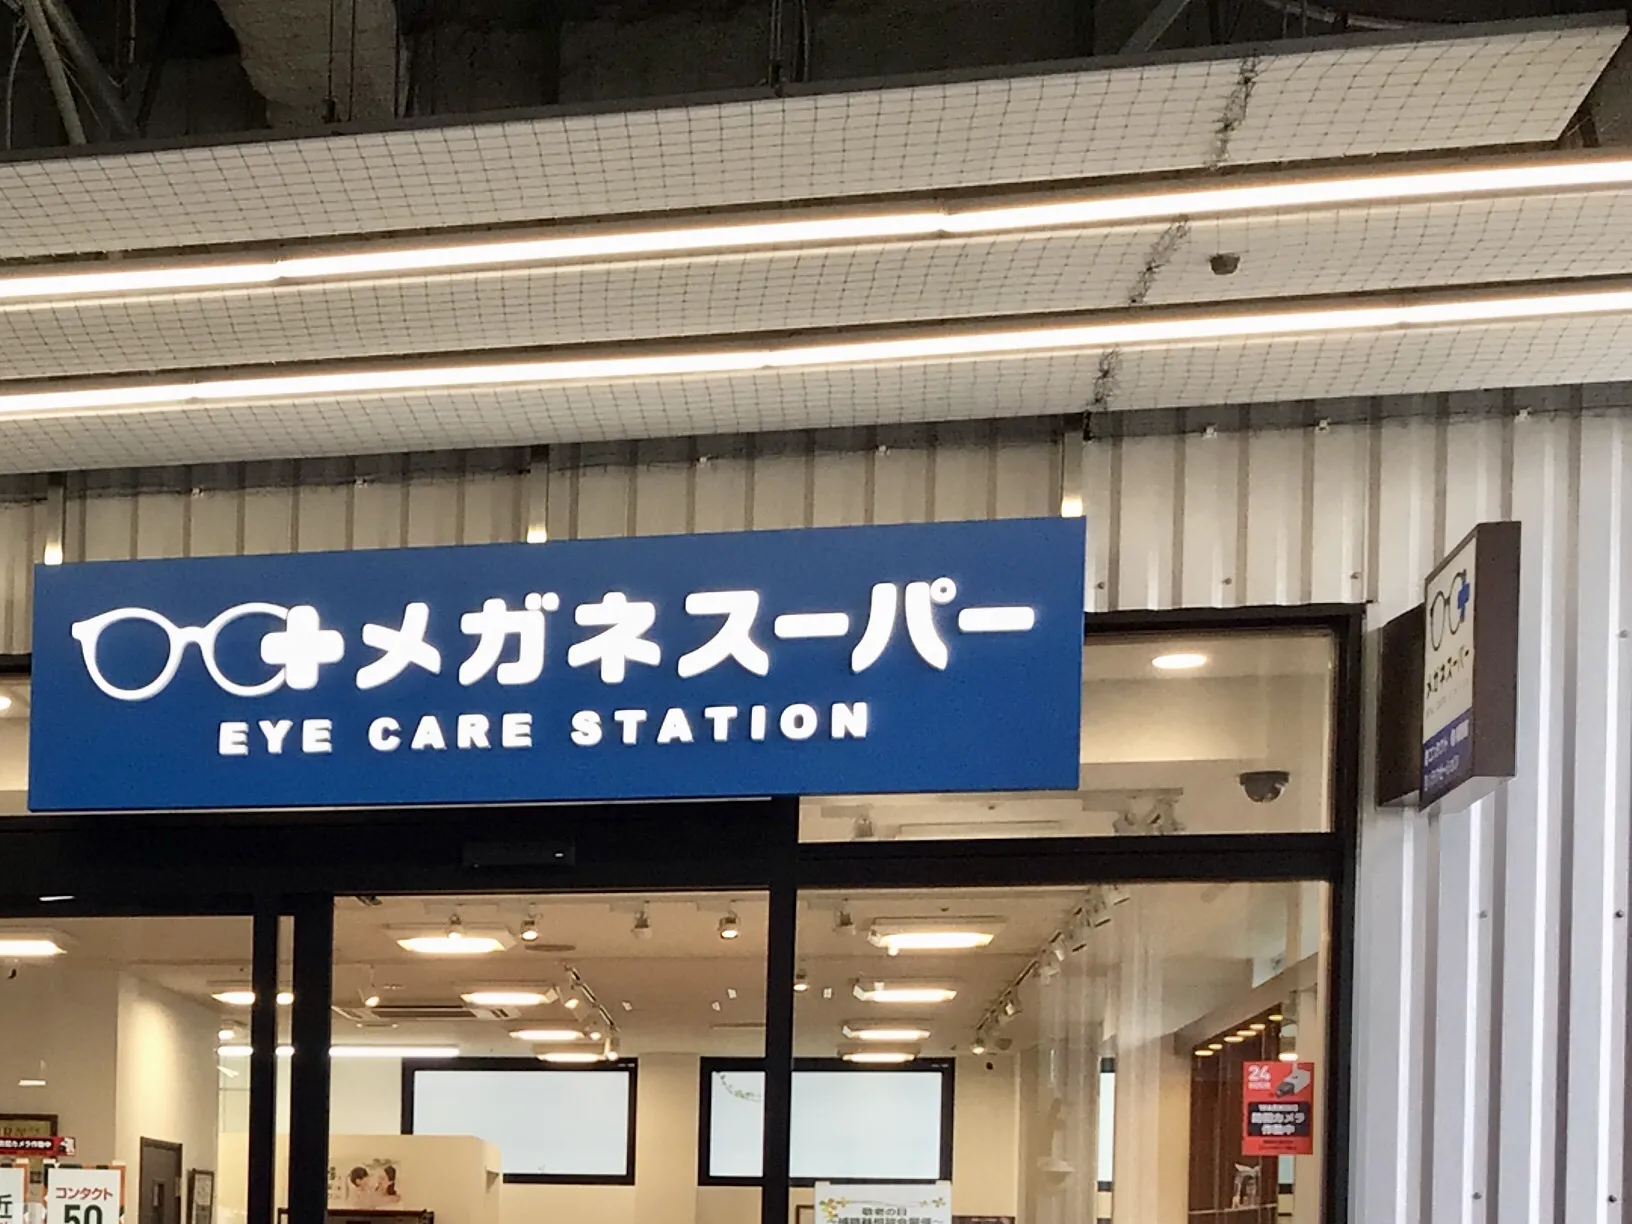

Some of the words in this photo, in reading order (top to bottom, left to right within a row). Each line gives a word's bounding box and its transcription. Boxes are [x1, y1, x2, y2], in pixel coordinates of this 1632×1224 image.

[356, 577, 1035, 689] メガネスーパー
[218, 718, 332, 755] EYE
[368, 711, 533, 749] CARE
[570, 701, 869, 746] STATION
[56, 1187, 113, 1201] コンタクト
